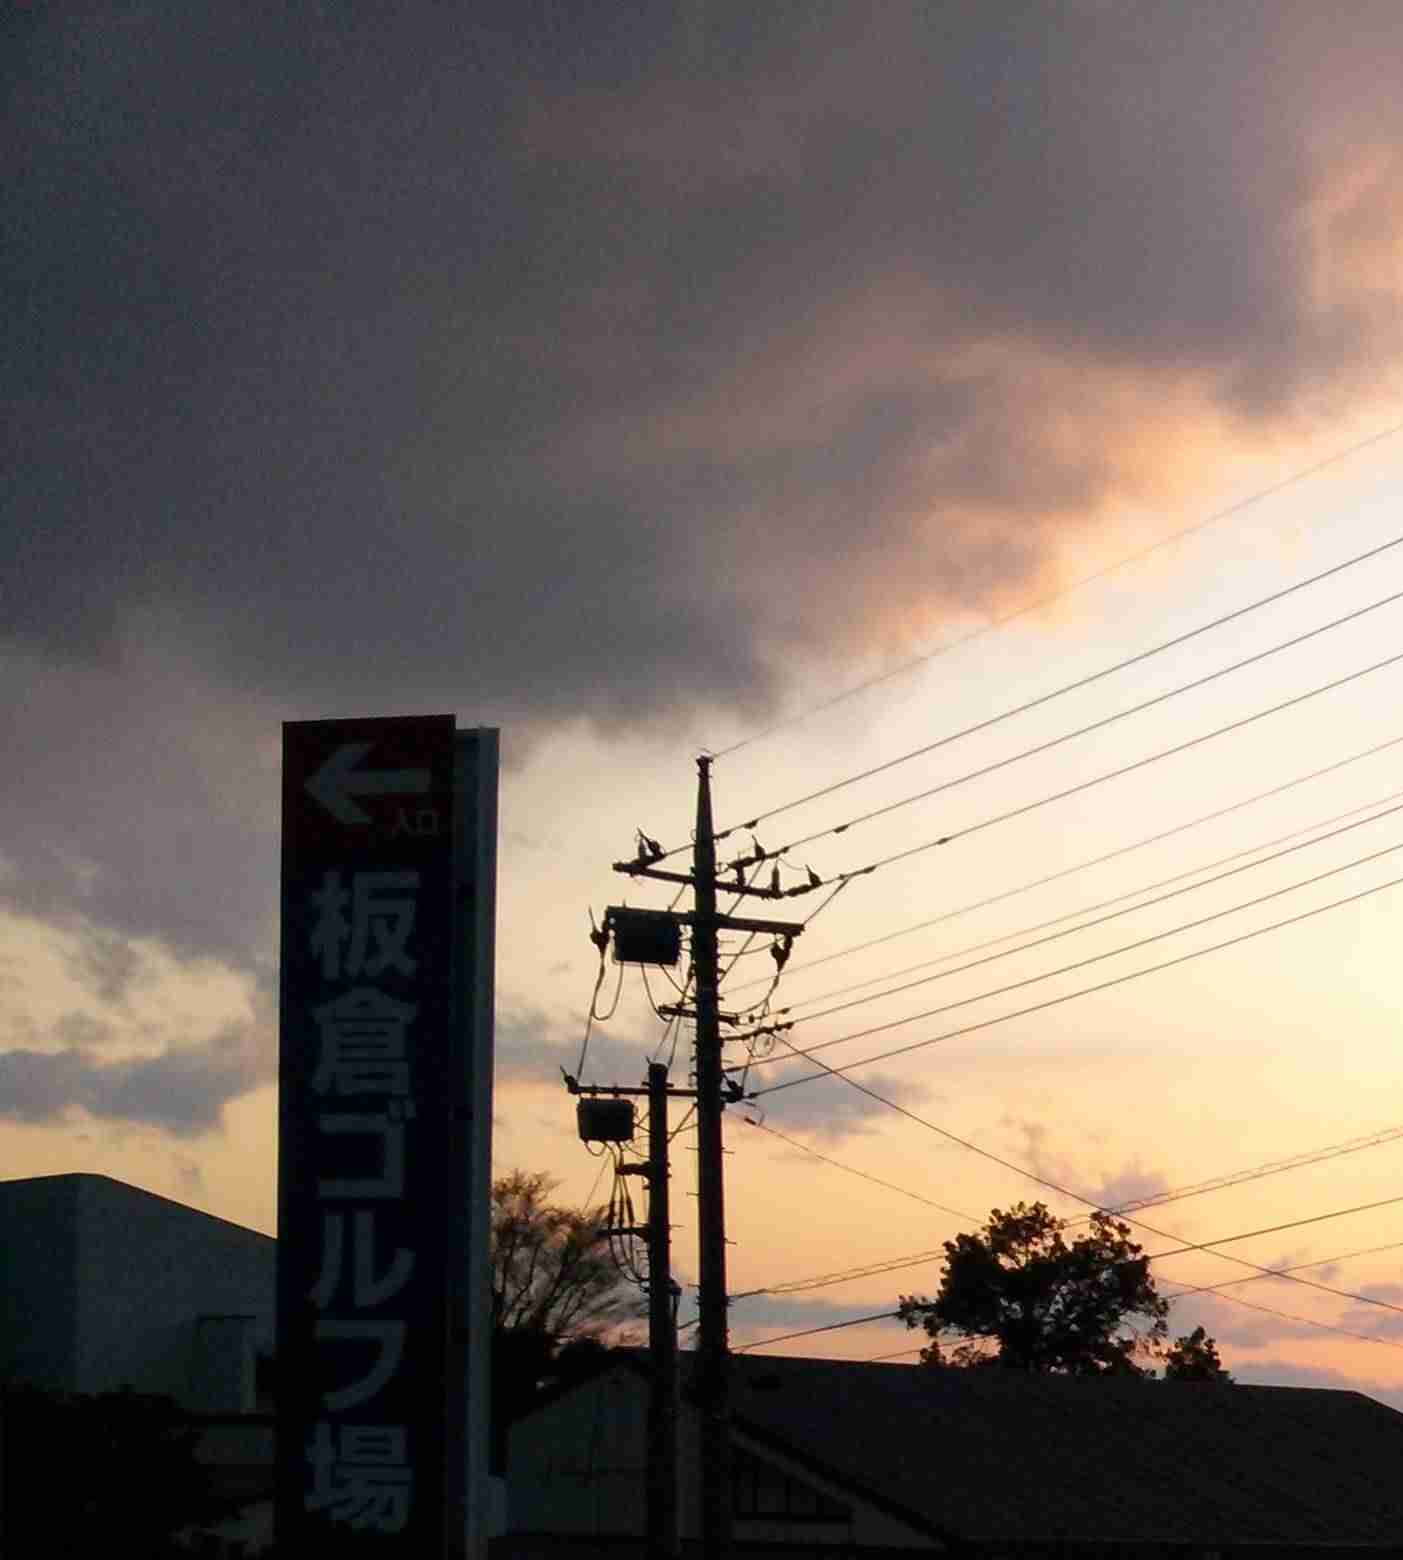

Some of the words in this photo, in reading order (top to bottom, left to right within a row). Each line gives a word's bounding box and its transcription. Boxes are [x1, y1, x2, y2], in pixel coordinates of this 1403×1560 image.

[391, 807, 441, 839] 入口
[304, 867, 420, 1533] 板倉ゴルフ場
